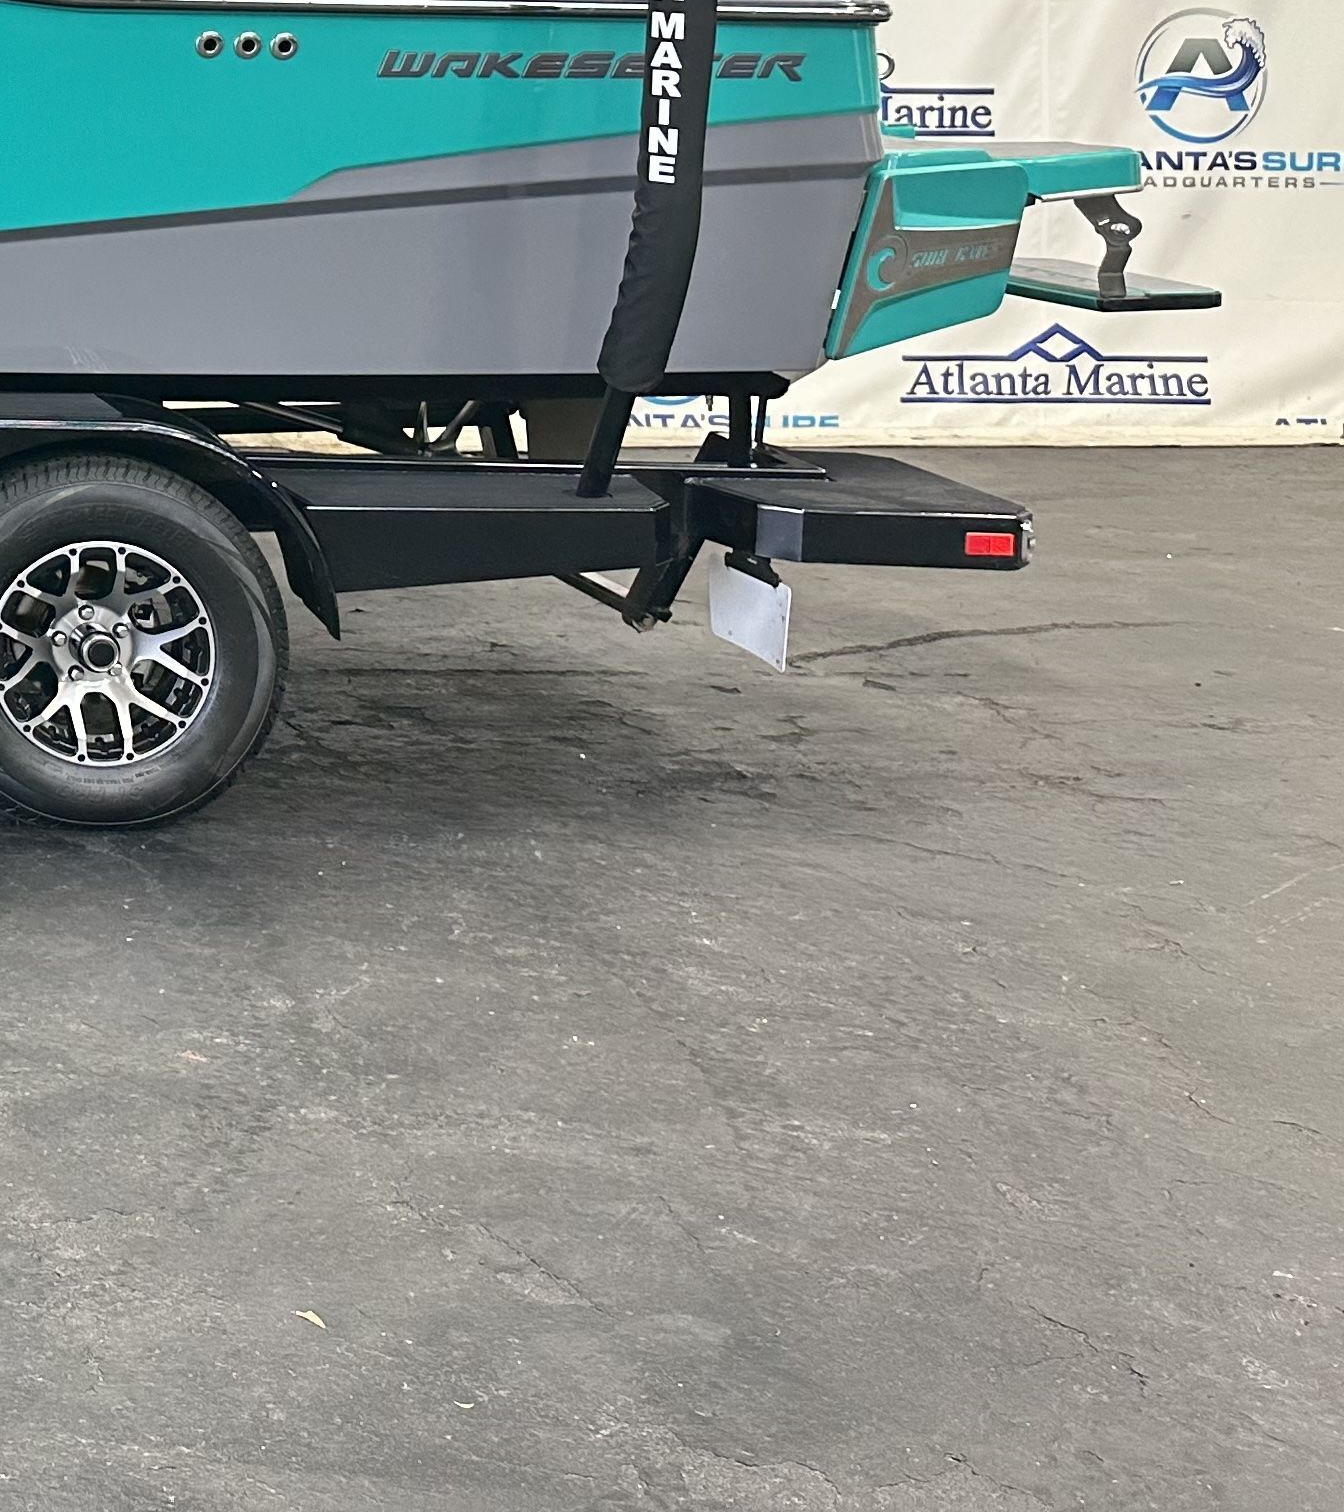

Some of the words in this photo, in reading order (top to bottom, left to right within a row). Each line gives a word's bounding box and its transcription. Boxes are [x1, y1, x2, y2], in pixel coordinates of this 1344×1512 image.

[377, 49, 807, 82] WAKESEER
[648, 12, 685, 184] MARINE
[882, 96, 992, 129] arine
[1262, 152, 1341, 172] SUR
[1143, 176, 1316, 190] ADQUARTERS
[909, 364, 1052, 397] Atlanta
[1066, 365, 1208, 398] Marine
